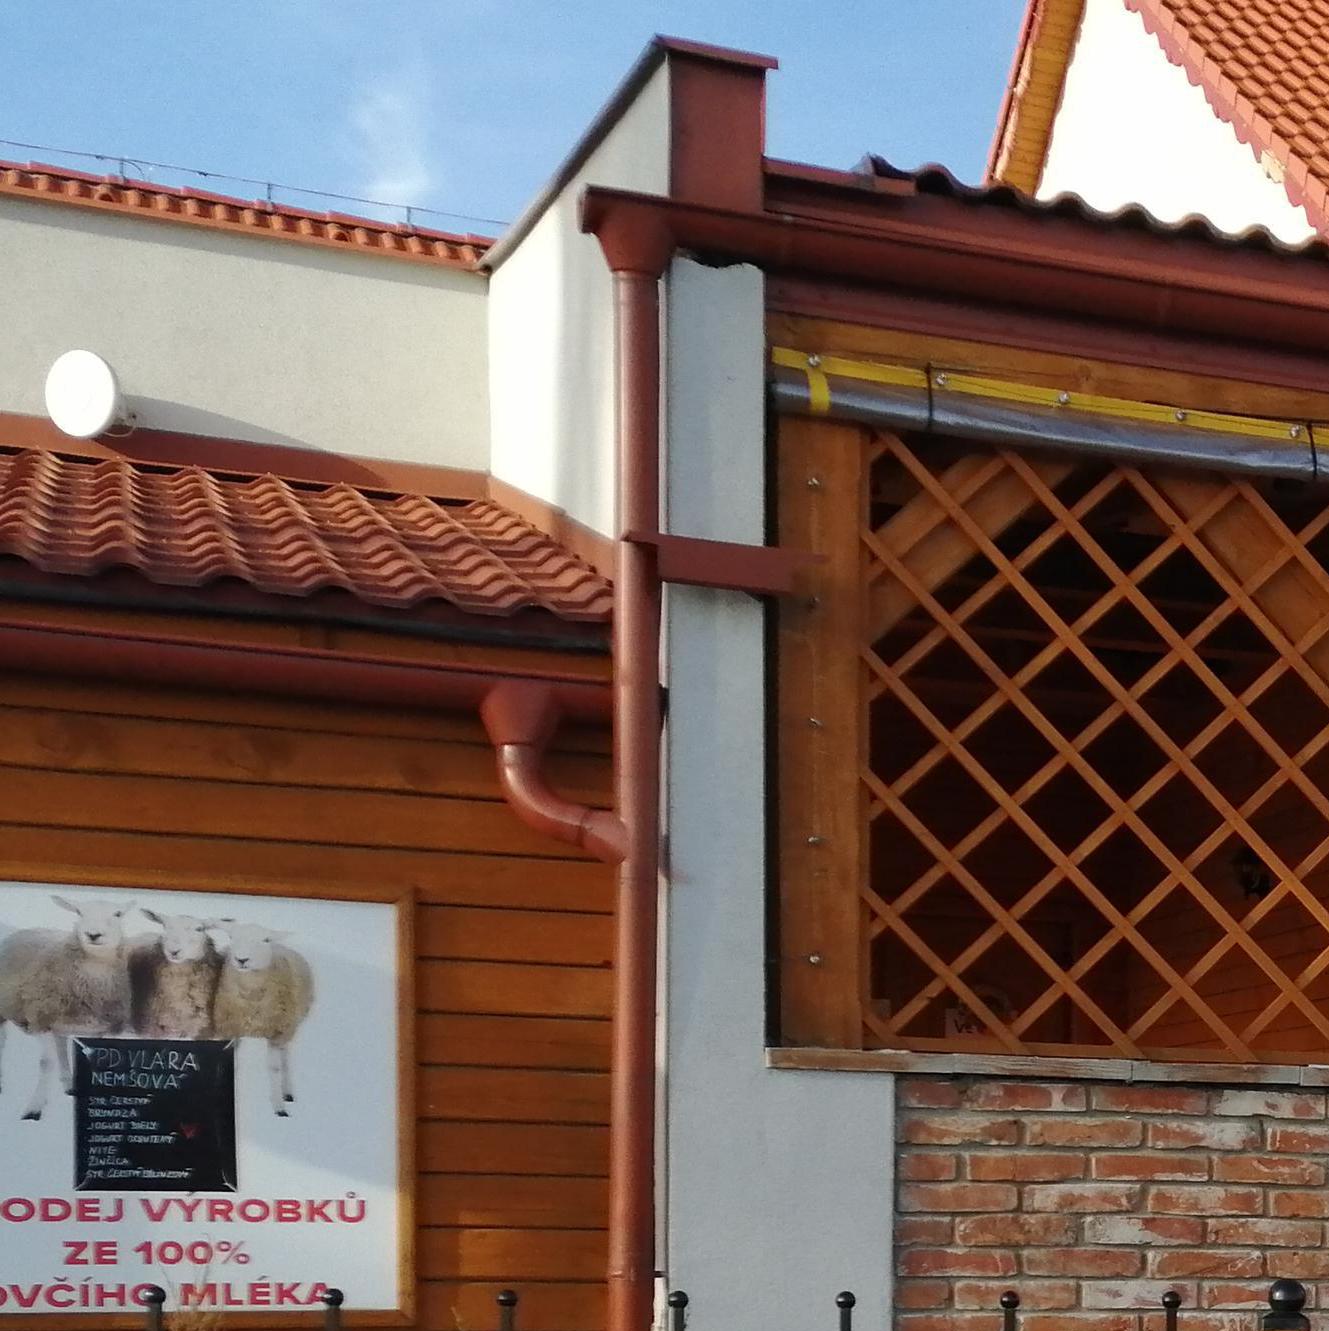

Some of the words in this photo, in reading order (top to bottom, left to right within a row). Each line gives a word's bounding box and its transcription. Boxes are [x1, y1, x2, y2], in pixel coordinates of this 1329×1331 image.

[139, 1191, 366, 1223] VÝROBKŮ
[62, 1240, 118, 1266] ZE
[132, 1240, 250, 1266] 100%
